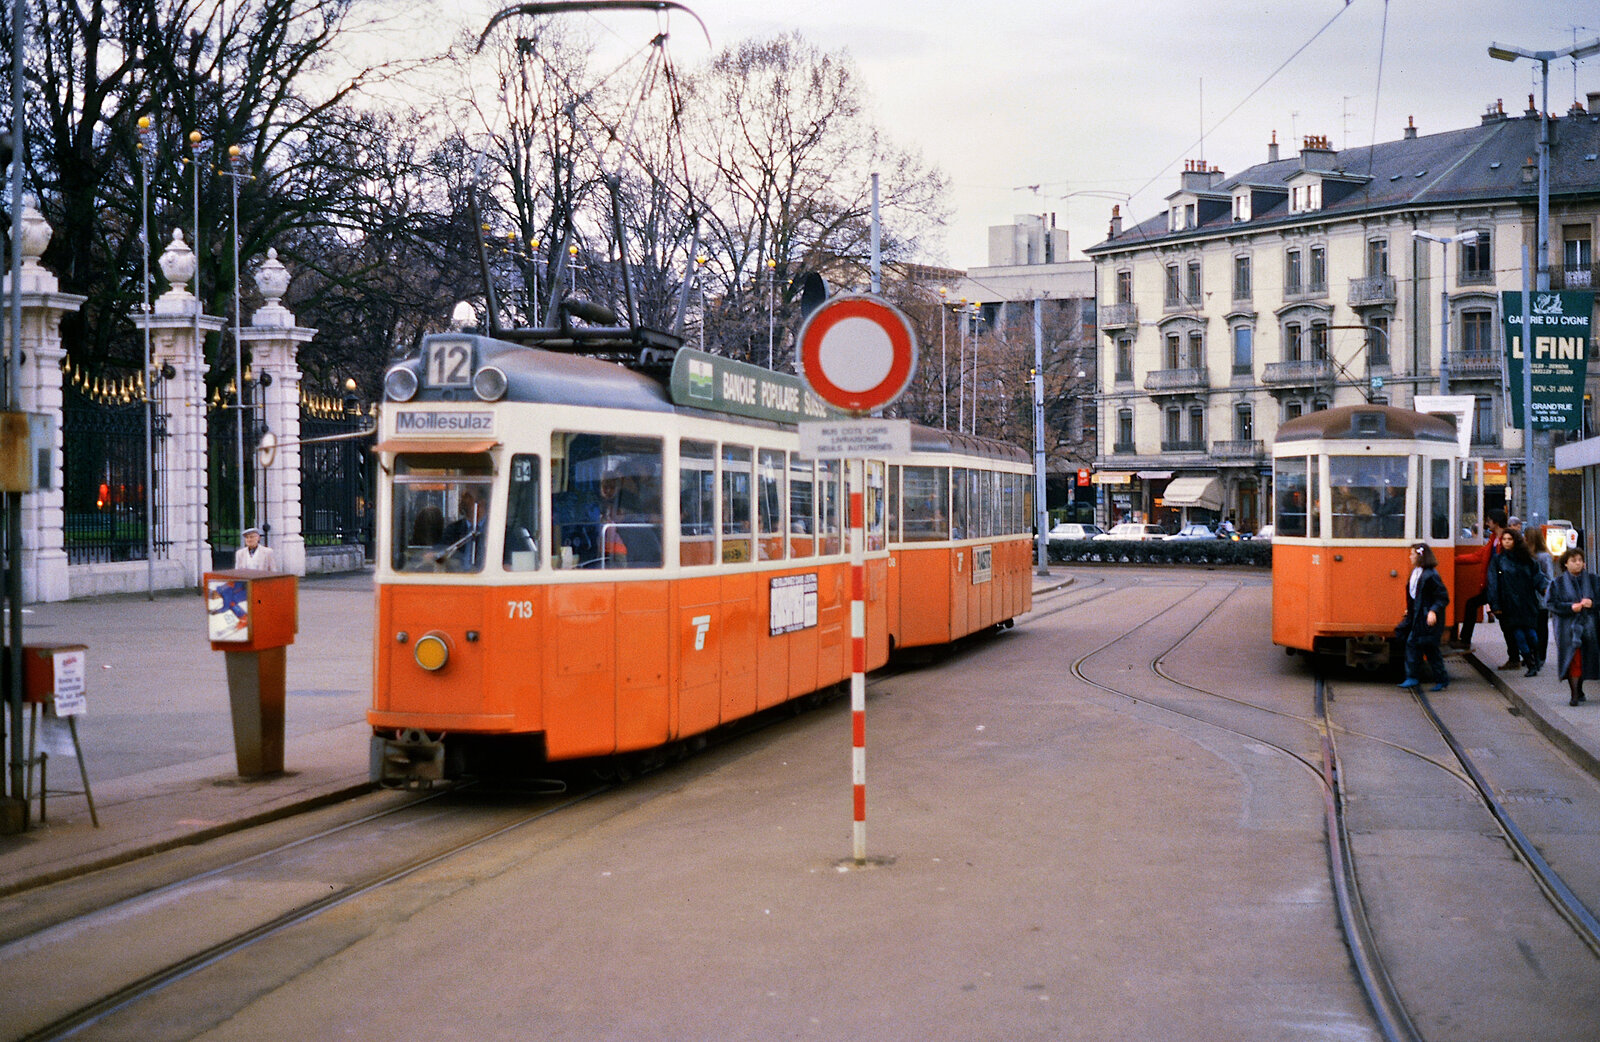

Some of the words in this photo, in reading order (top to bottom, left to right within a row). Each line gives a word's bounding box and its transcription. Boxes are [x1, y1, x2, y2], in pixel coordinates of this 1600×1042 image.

[1508, 315, 1544, 325] GALRIE
[1546, 316, 1558, 325] DU
[1560, 316, 1589, 325] CYGNE
[1536, 336, 1584, 360] FINI
[434, 346, 469, 383] 12
[723, 372, 756, 405] BANQUE
[761, 381, 799, 413] POPULAIRE
[400, 412, 492, 429] Moillesulaz
[508, 601, 533, 618] 713
